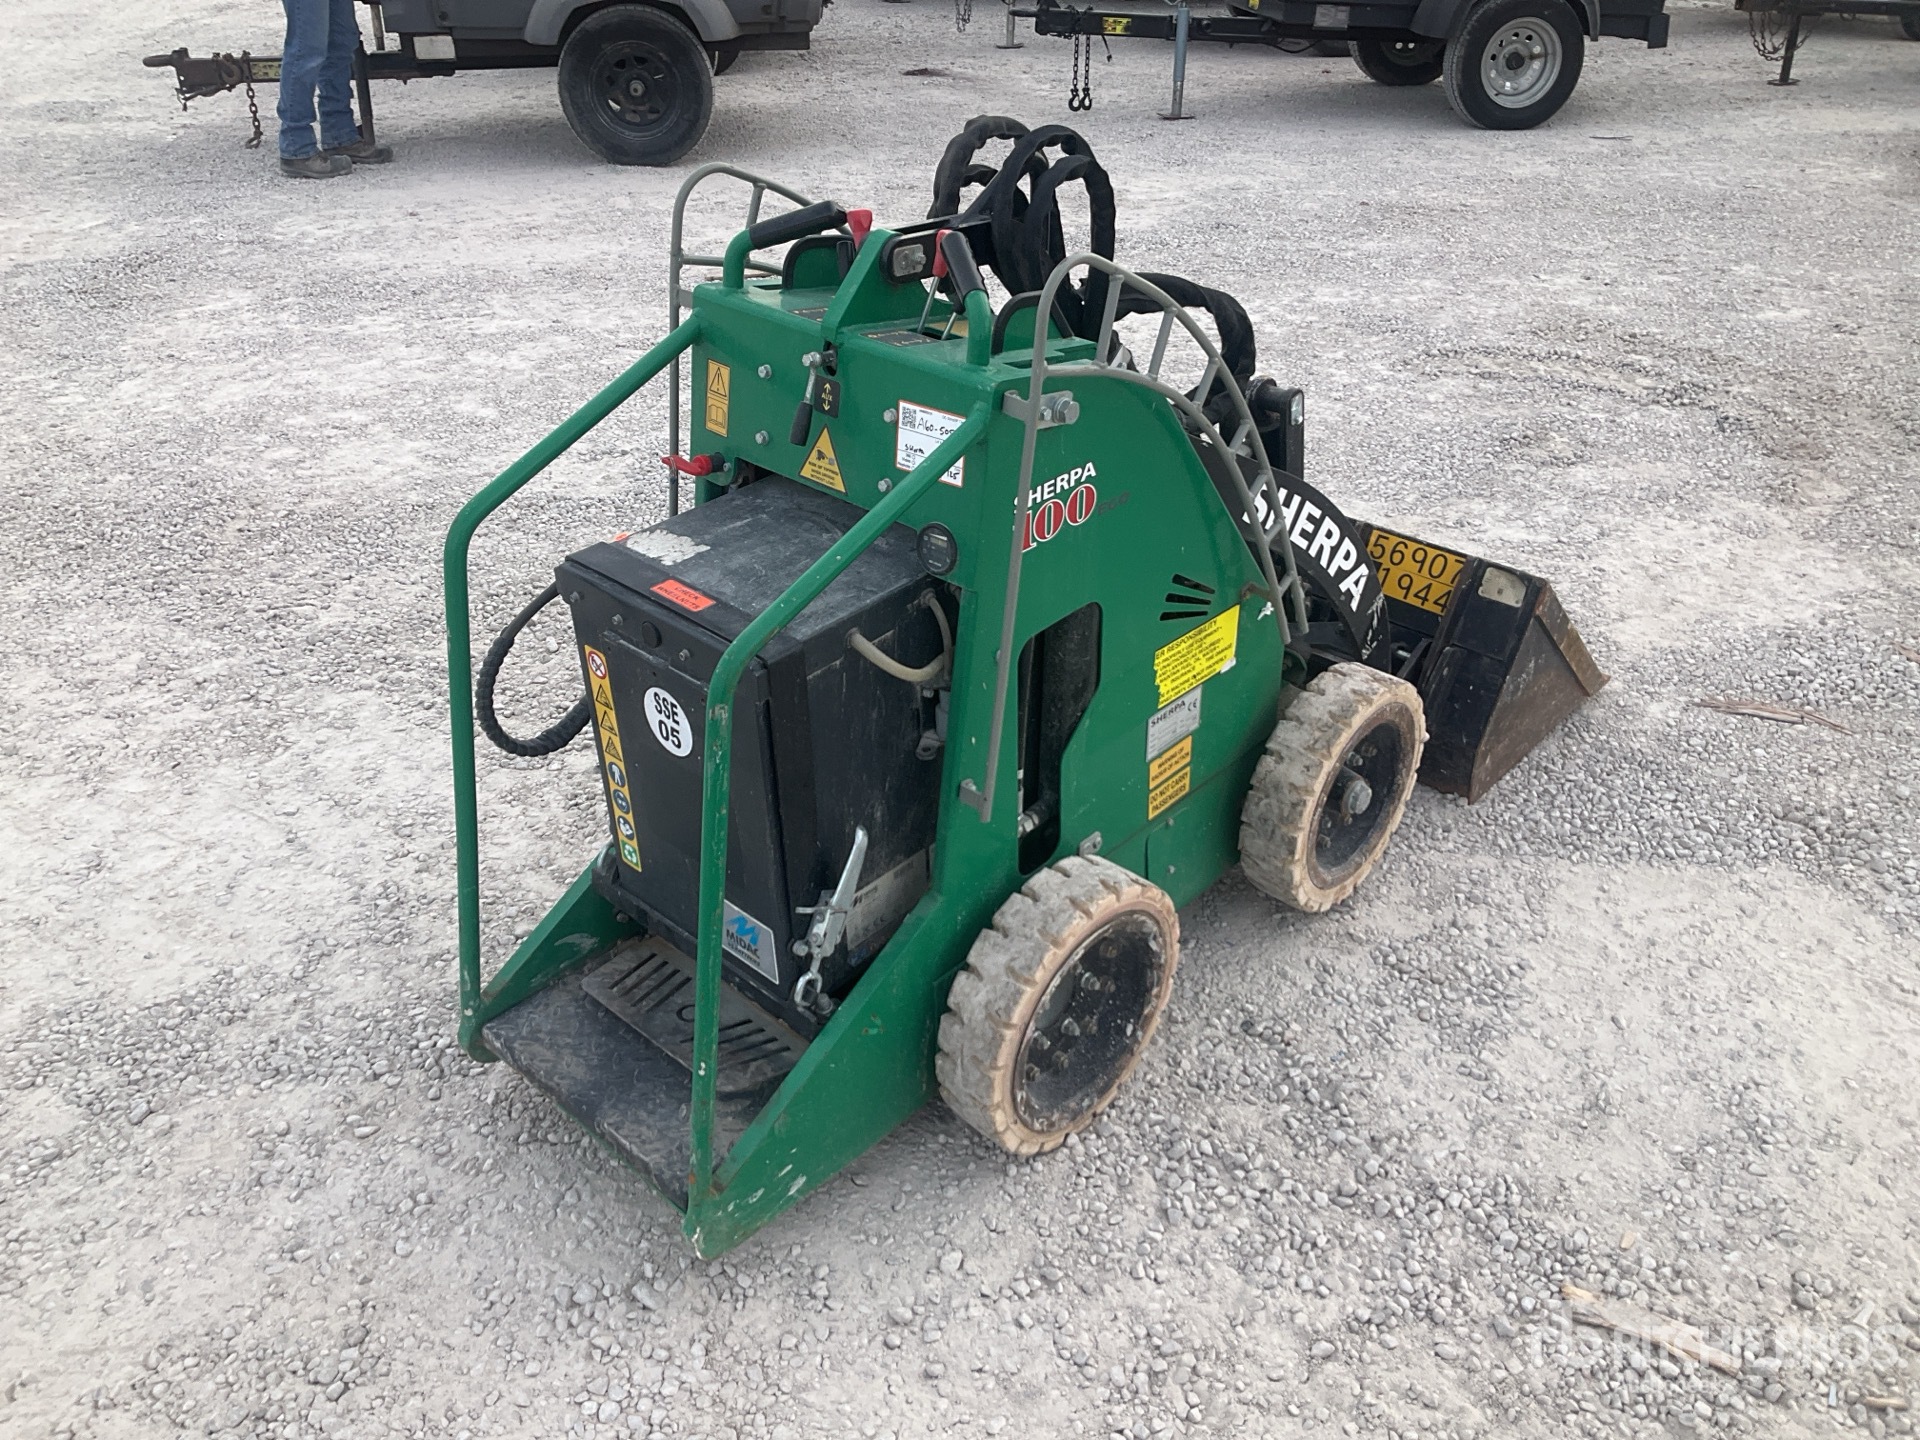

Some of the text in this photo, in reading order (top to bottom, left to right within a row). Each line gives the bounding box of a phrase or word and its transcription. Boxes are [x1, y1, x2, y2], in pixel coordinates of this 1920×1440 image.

[821, 393, 833, 402] AUX
[1013, 484, 1097, 553] 100
[673, 586, 700, 600] CHECK
[1166, 619, 1216, 653] RESPONSIBILITY
[653, 691, 680, 727] SSE
[1151, 701, 1186, 728] SHERPA
[658, 719, 682, 749] 05
[1170, 770, 1187, 789] CARRY
[1151, 781, 1185, 814] PASSENGERS
[726, 928, 759, 959] MIDAC
